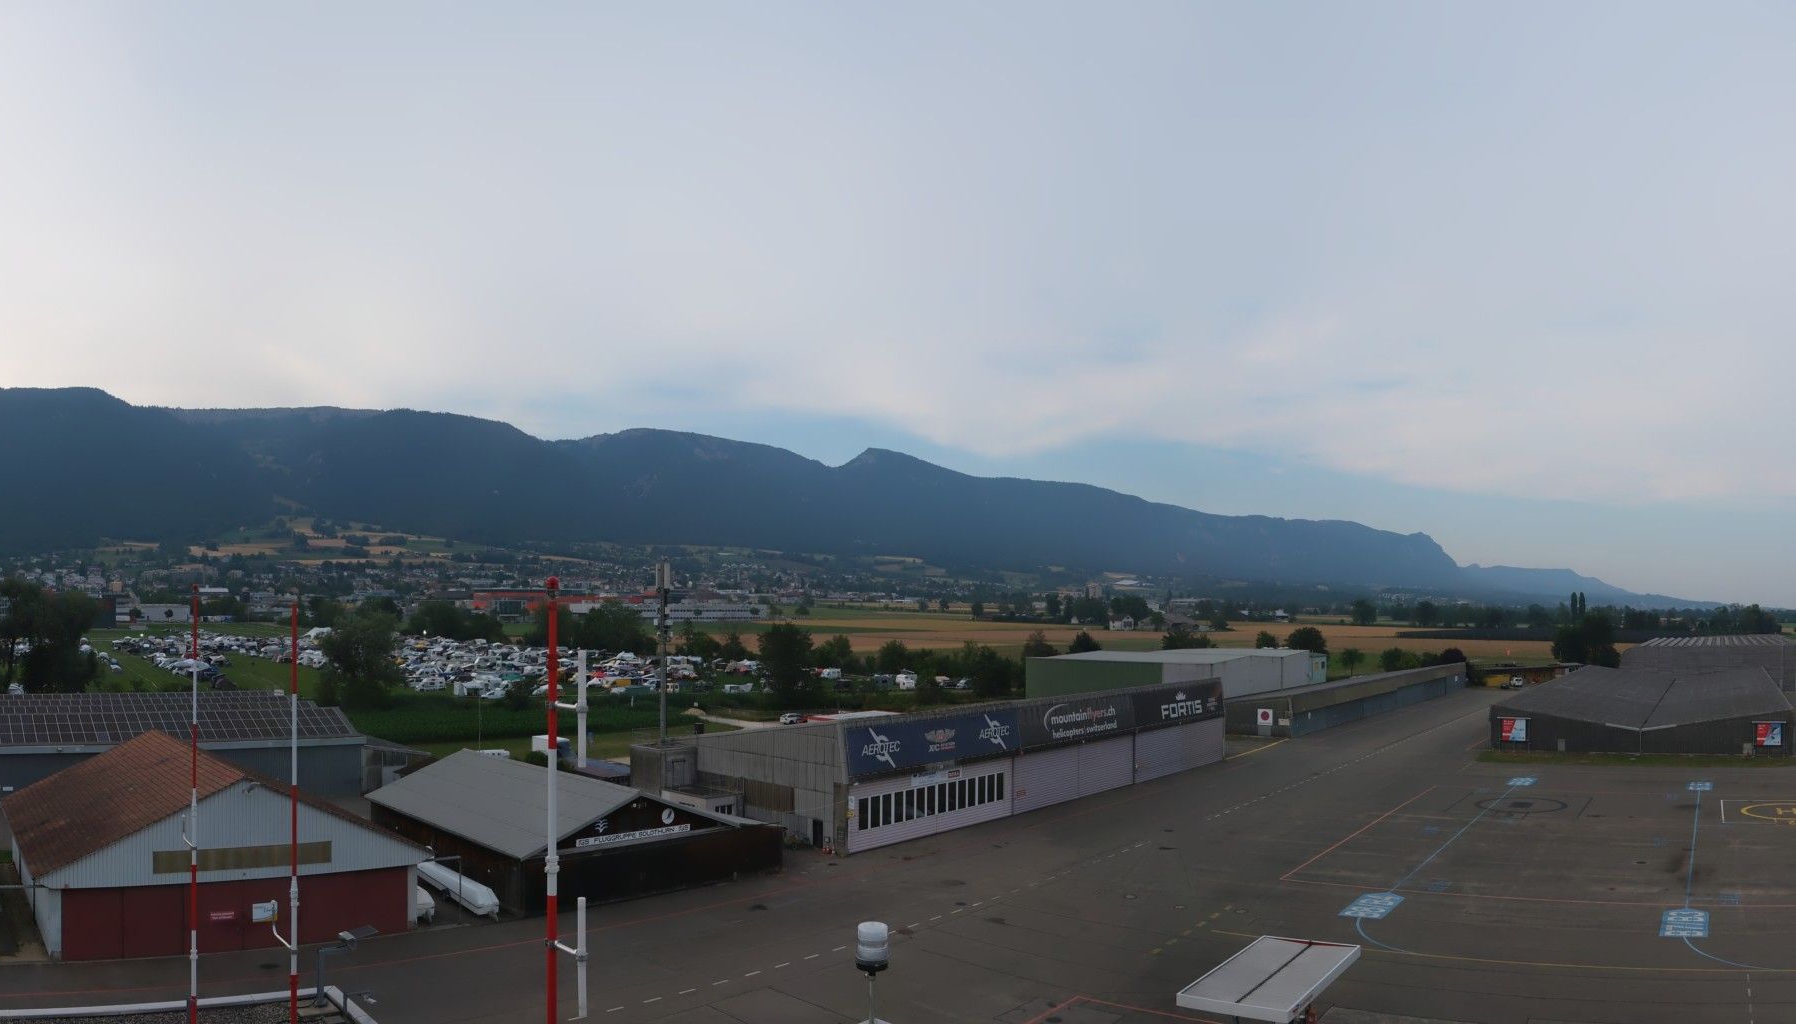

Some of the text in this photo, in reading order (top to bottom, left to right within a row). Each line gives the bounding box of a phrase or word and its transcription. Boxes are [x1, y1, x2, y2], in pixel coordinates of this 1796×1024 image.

[1050, 705, 1116, 725] mountainflyers.ch
[1161, 700, 1203, 720] FORTIS
[979, 725, 1010, 740] AEROTEC
[862, 740, 901, 756] AEROTEC
[594, 833, 637, 843] FLUGGRUPPE
[638, 828, 675, 837] SOLOTHURN
